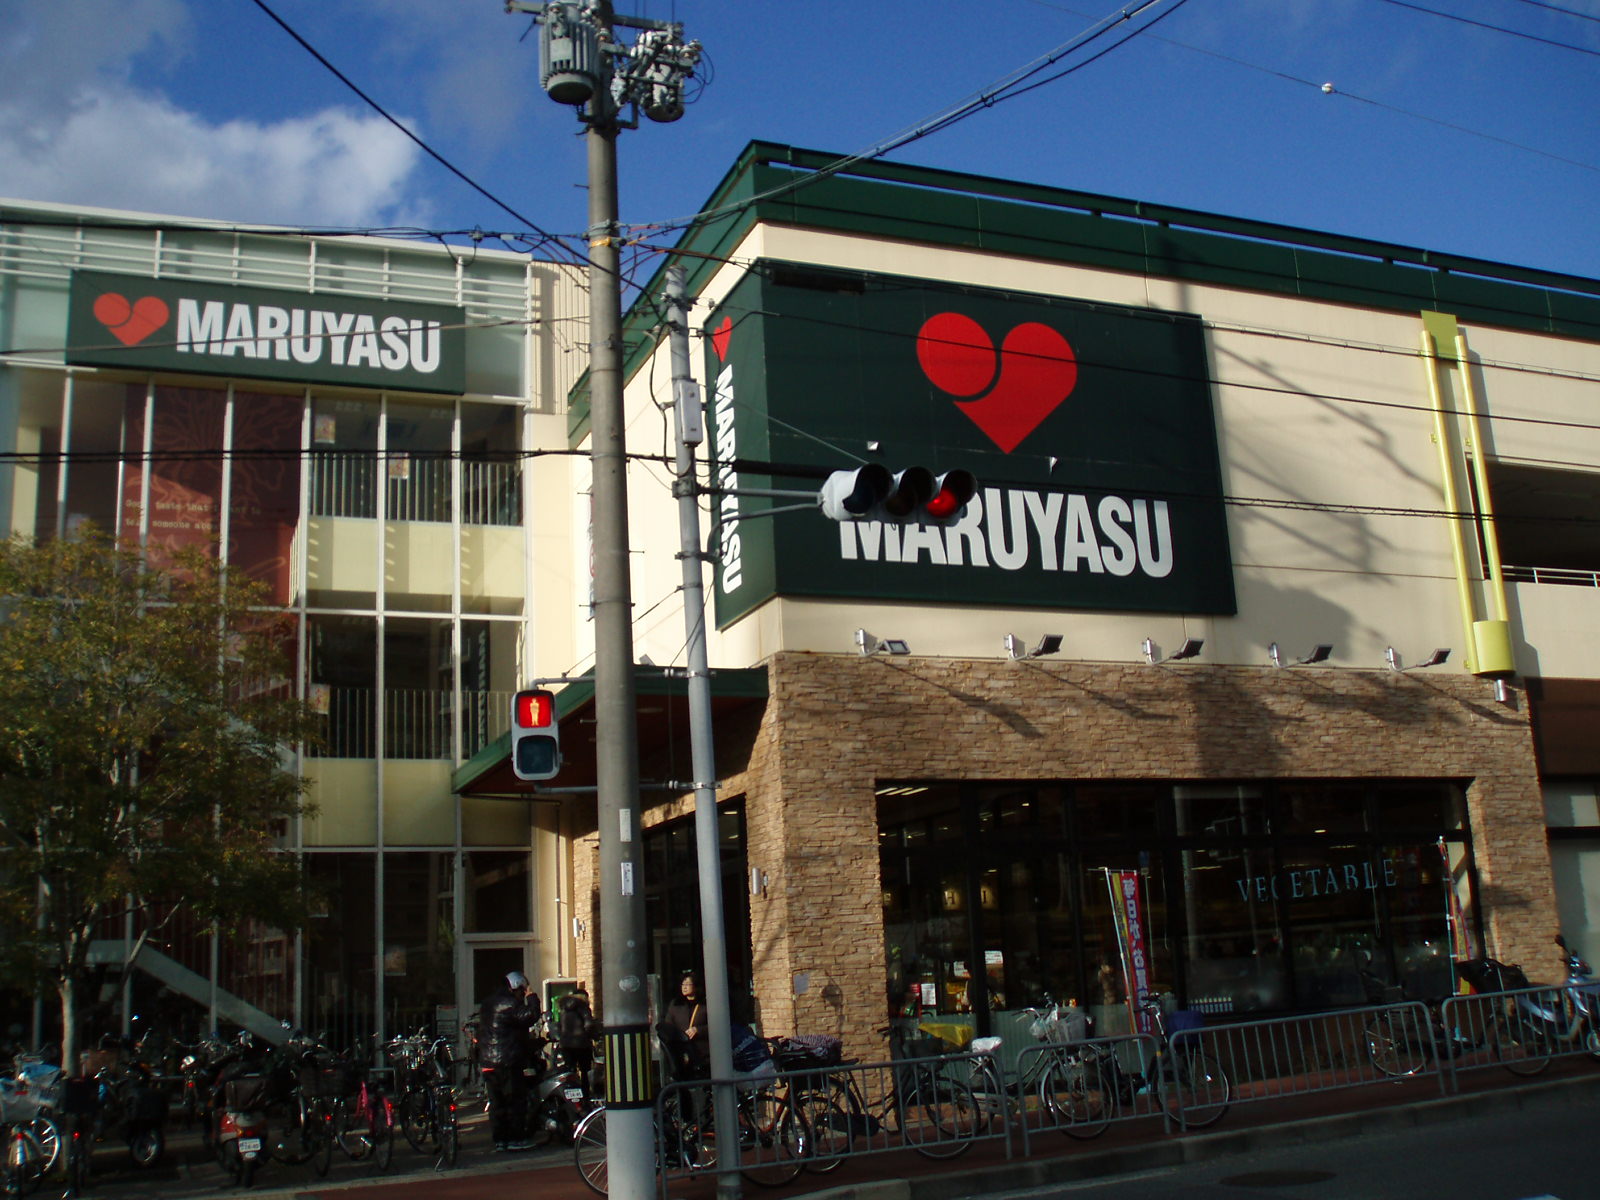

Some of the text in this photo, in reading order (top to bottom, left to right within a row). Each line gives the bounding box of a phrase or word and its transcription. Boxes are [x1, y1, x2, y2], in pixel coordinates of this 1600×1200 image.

[177, 298, 441, 373] MARUYASU
[152, 520, 190, 529] someone
[840, 487, 1173, 578] MARUYASU
